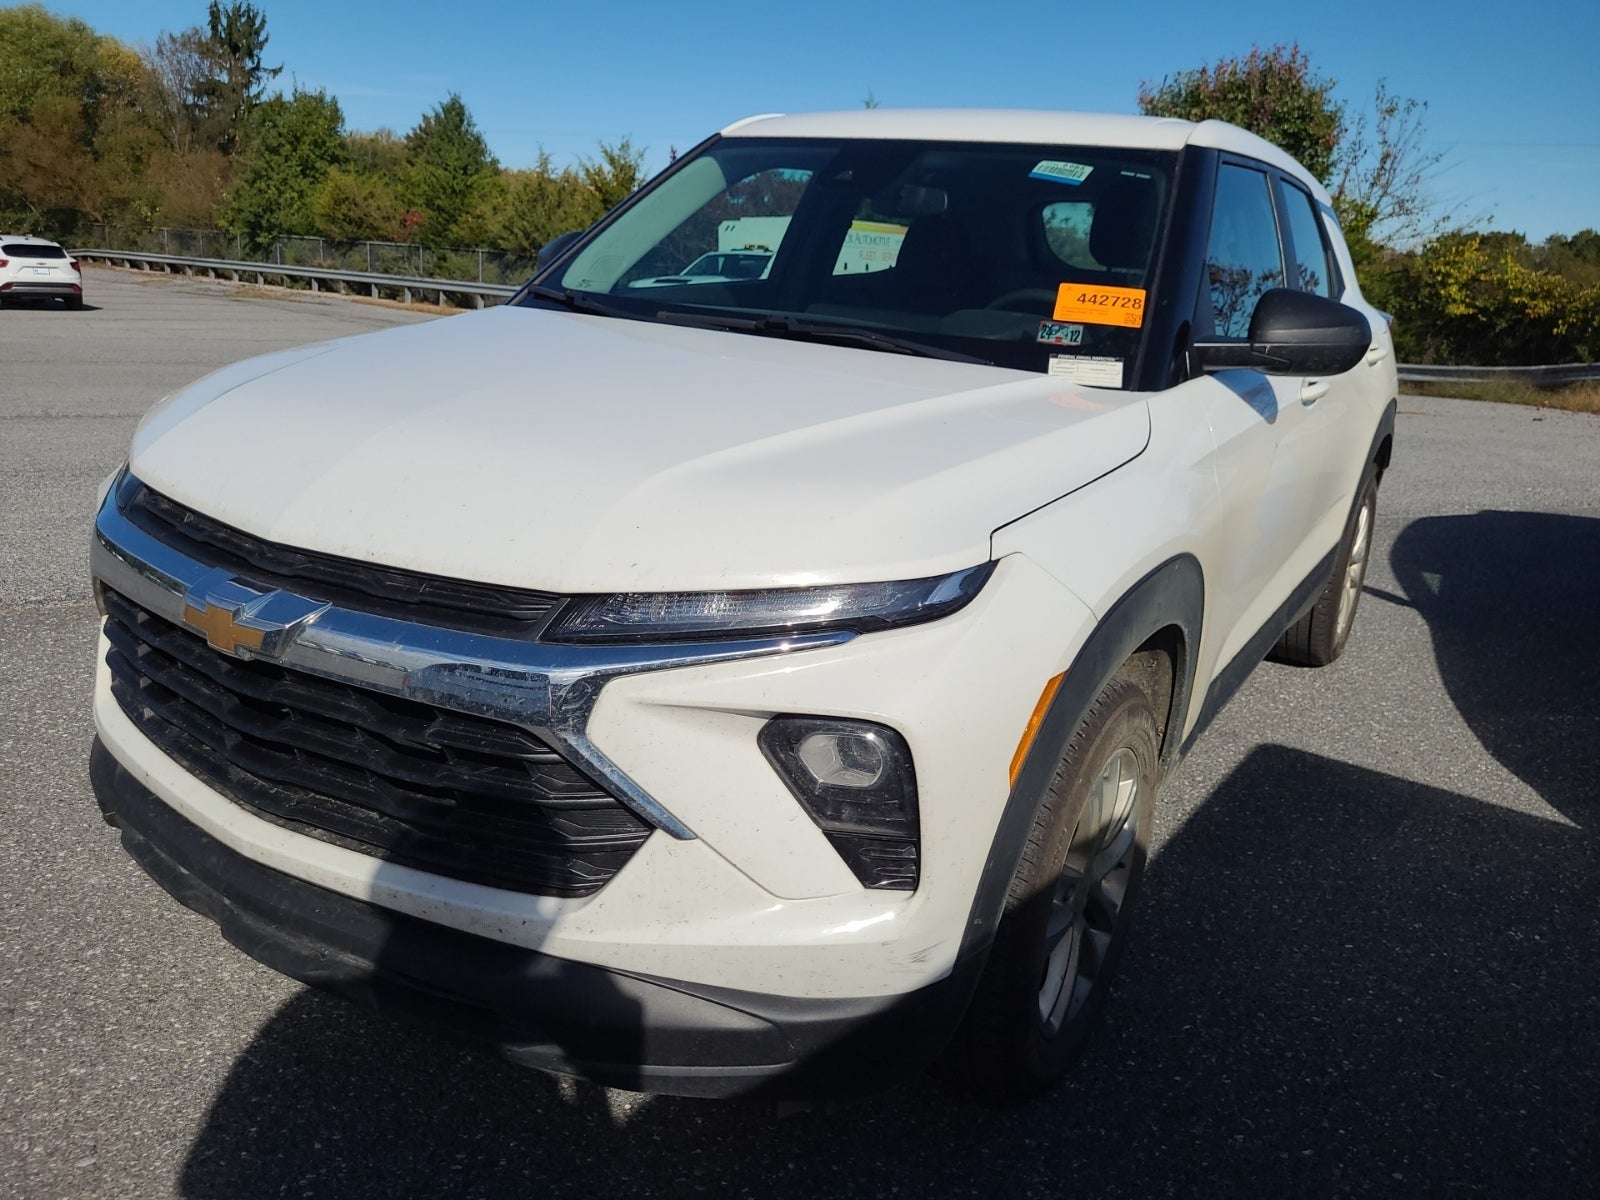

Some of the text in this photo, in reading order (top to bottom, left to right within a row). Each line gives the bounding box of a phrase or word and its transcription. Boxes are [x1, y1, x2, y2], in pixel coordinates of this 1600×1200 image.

[1077, 293, 1142, 309] 442728
[1041, 325, 1080, 342] 24 12
